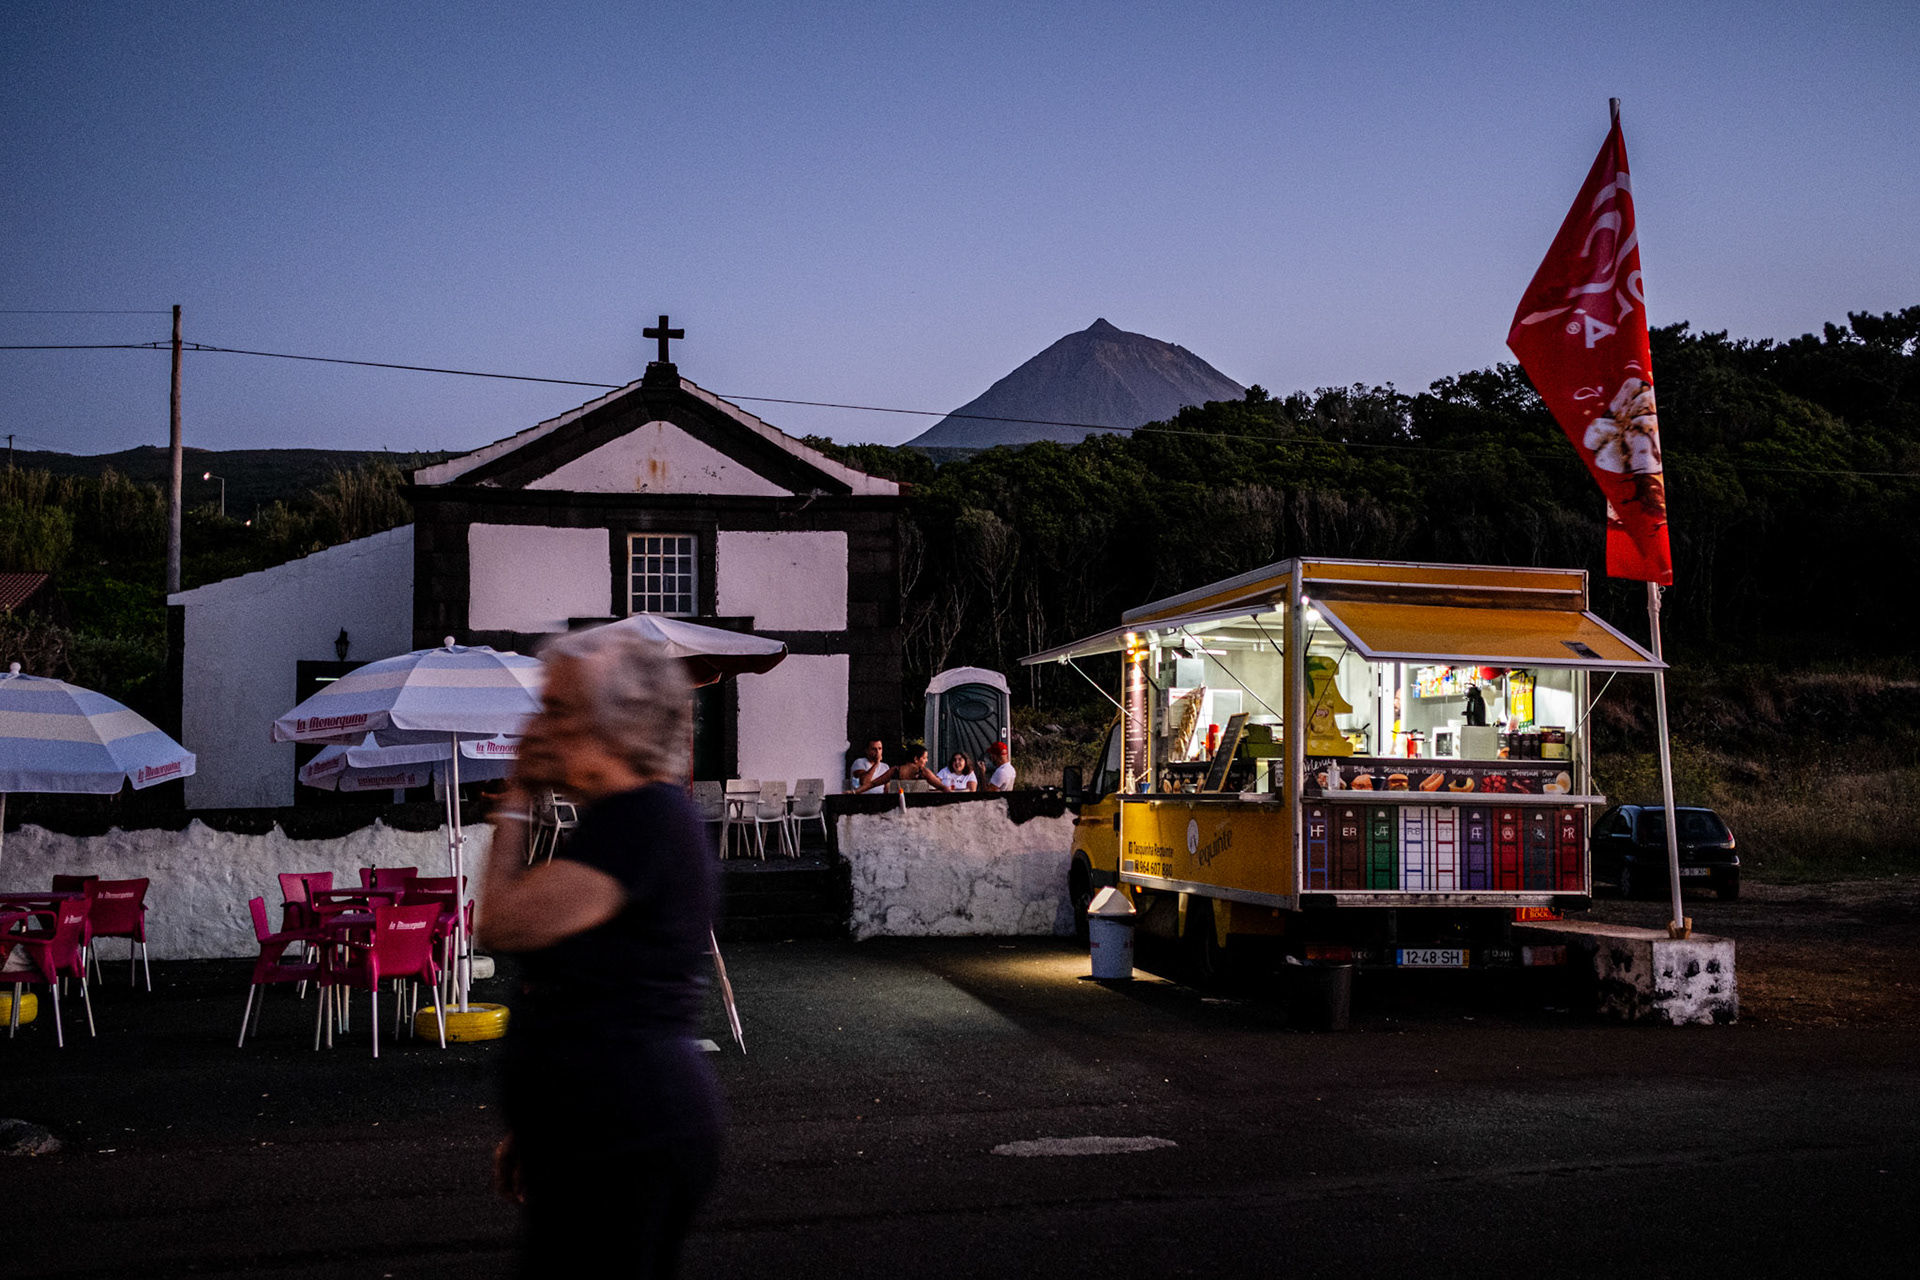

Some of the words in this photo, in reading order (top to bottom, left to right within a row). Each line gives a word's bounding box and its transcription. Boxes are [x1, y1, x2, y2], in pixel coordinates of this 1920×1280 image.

[297, 719, 306, 731] la
[309, 714, 368, 730] Menorquina
[476, 742, 484, 752] la
[487, 741, 520, 755] Menorq
[1342, 827, 1357, 836] ER
[1133, 842, 1153, 857] Tasquinha
[1140, 861, 1149, 873] 964
[1151, 862, 1160, 875] 607
[1162, 863, 1172, 877] 880
